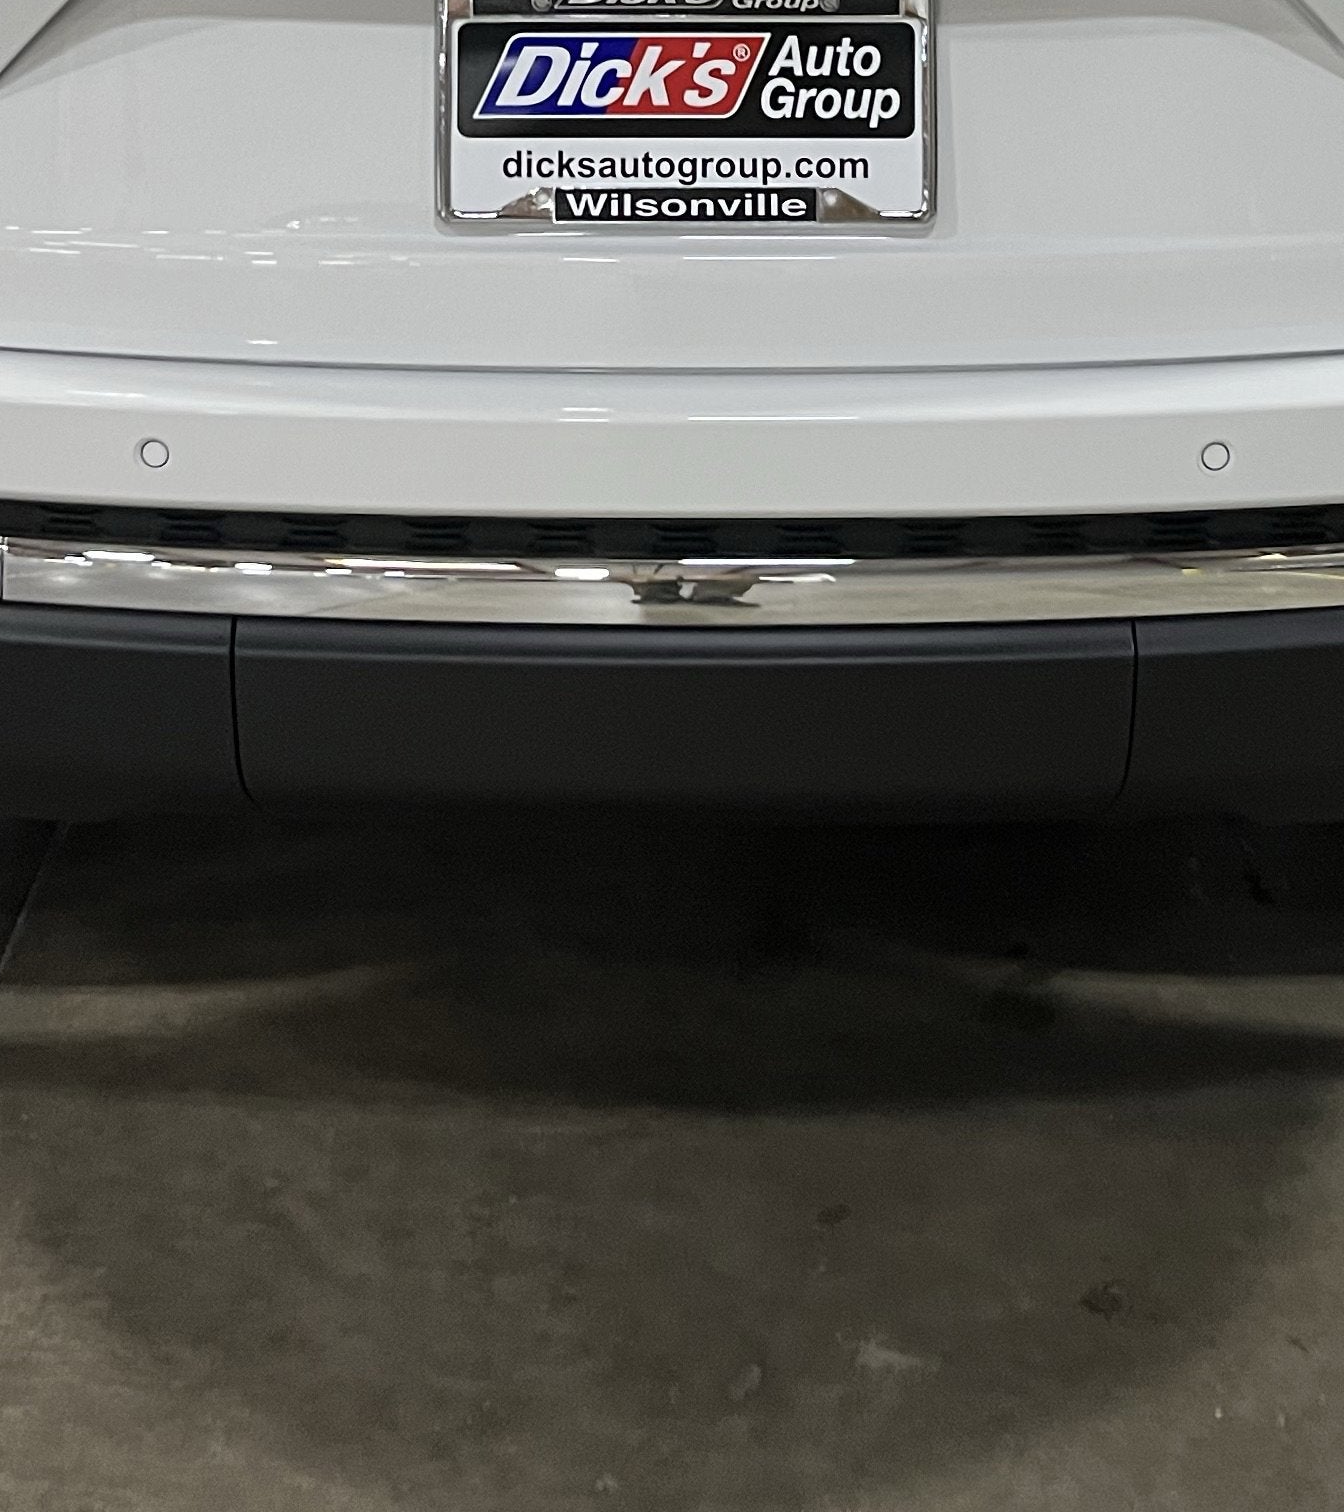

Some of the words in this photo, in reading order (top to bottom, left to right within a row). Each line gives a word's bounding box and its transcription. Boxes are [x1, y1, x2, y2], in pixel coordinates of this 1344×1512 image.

[495, 40, 734, 108] Dick's
[770, 35, 881, 77] Auto
[760, 79, 901, 128] Group
[502, 150, 869, 184] dicksautogroup.com
[566, 192, 808, 217] Wilsonville
